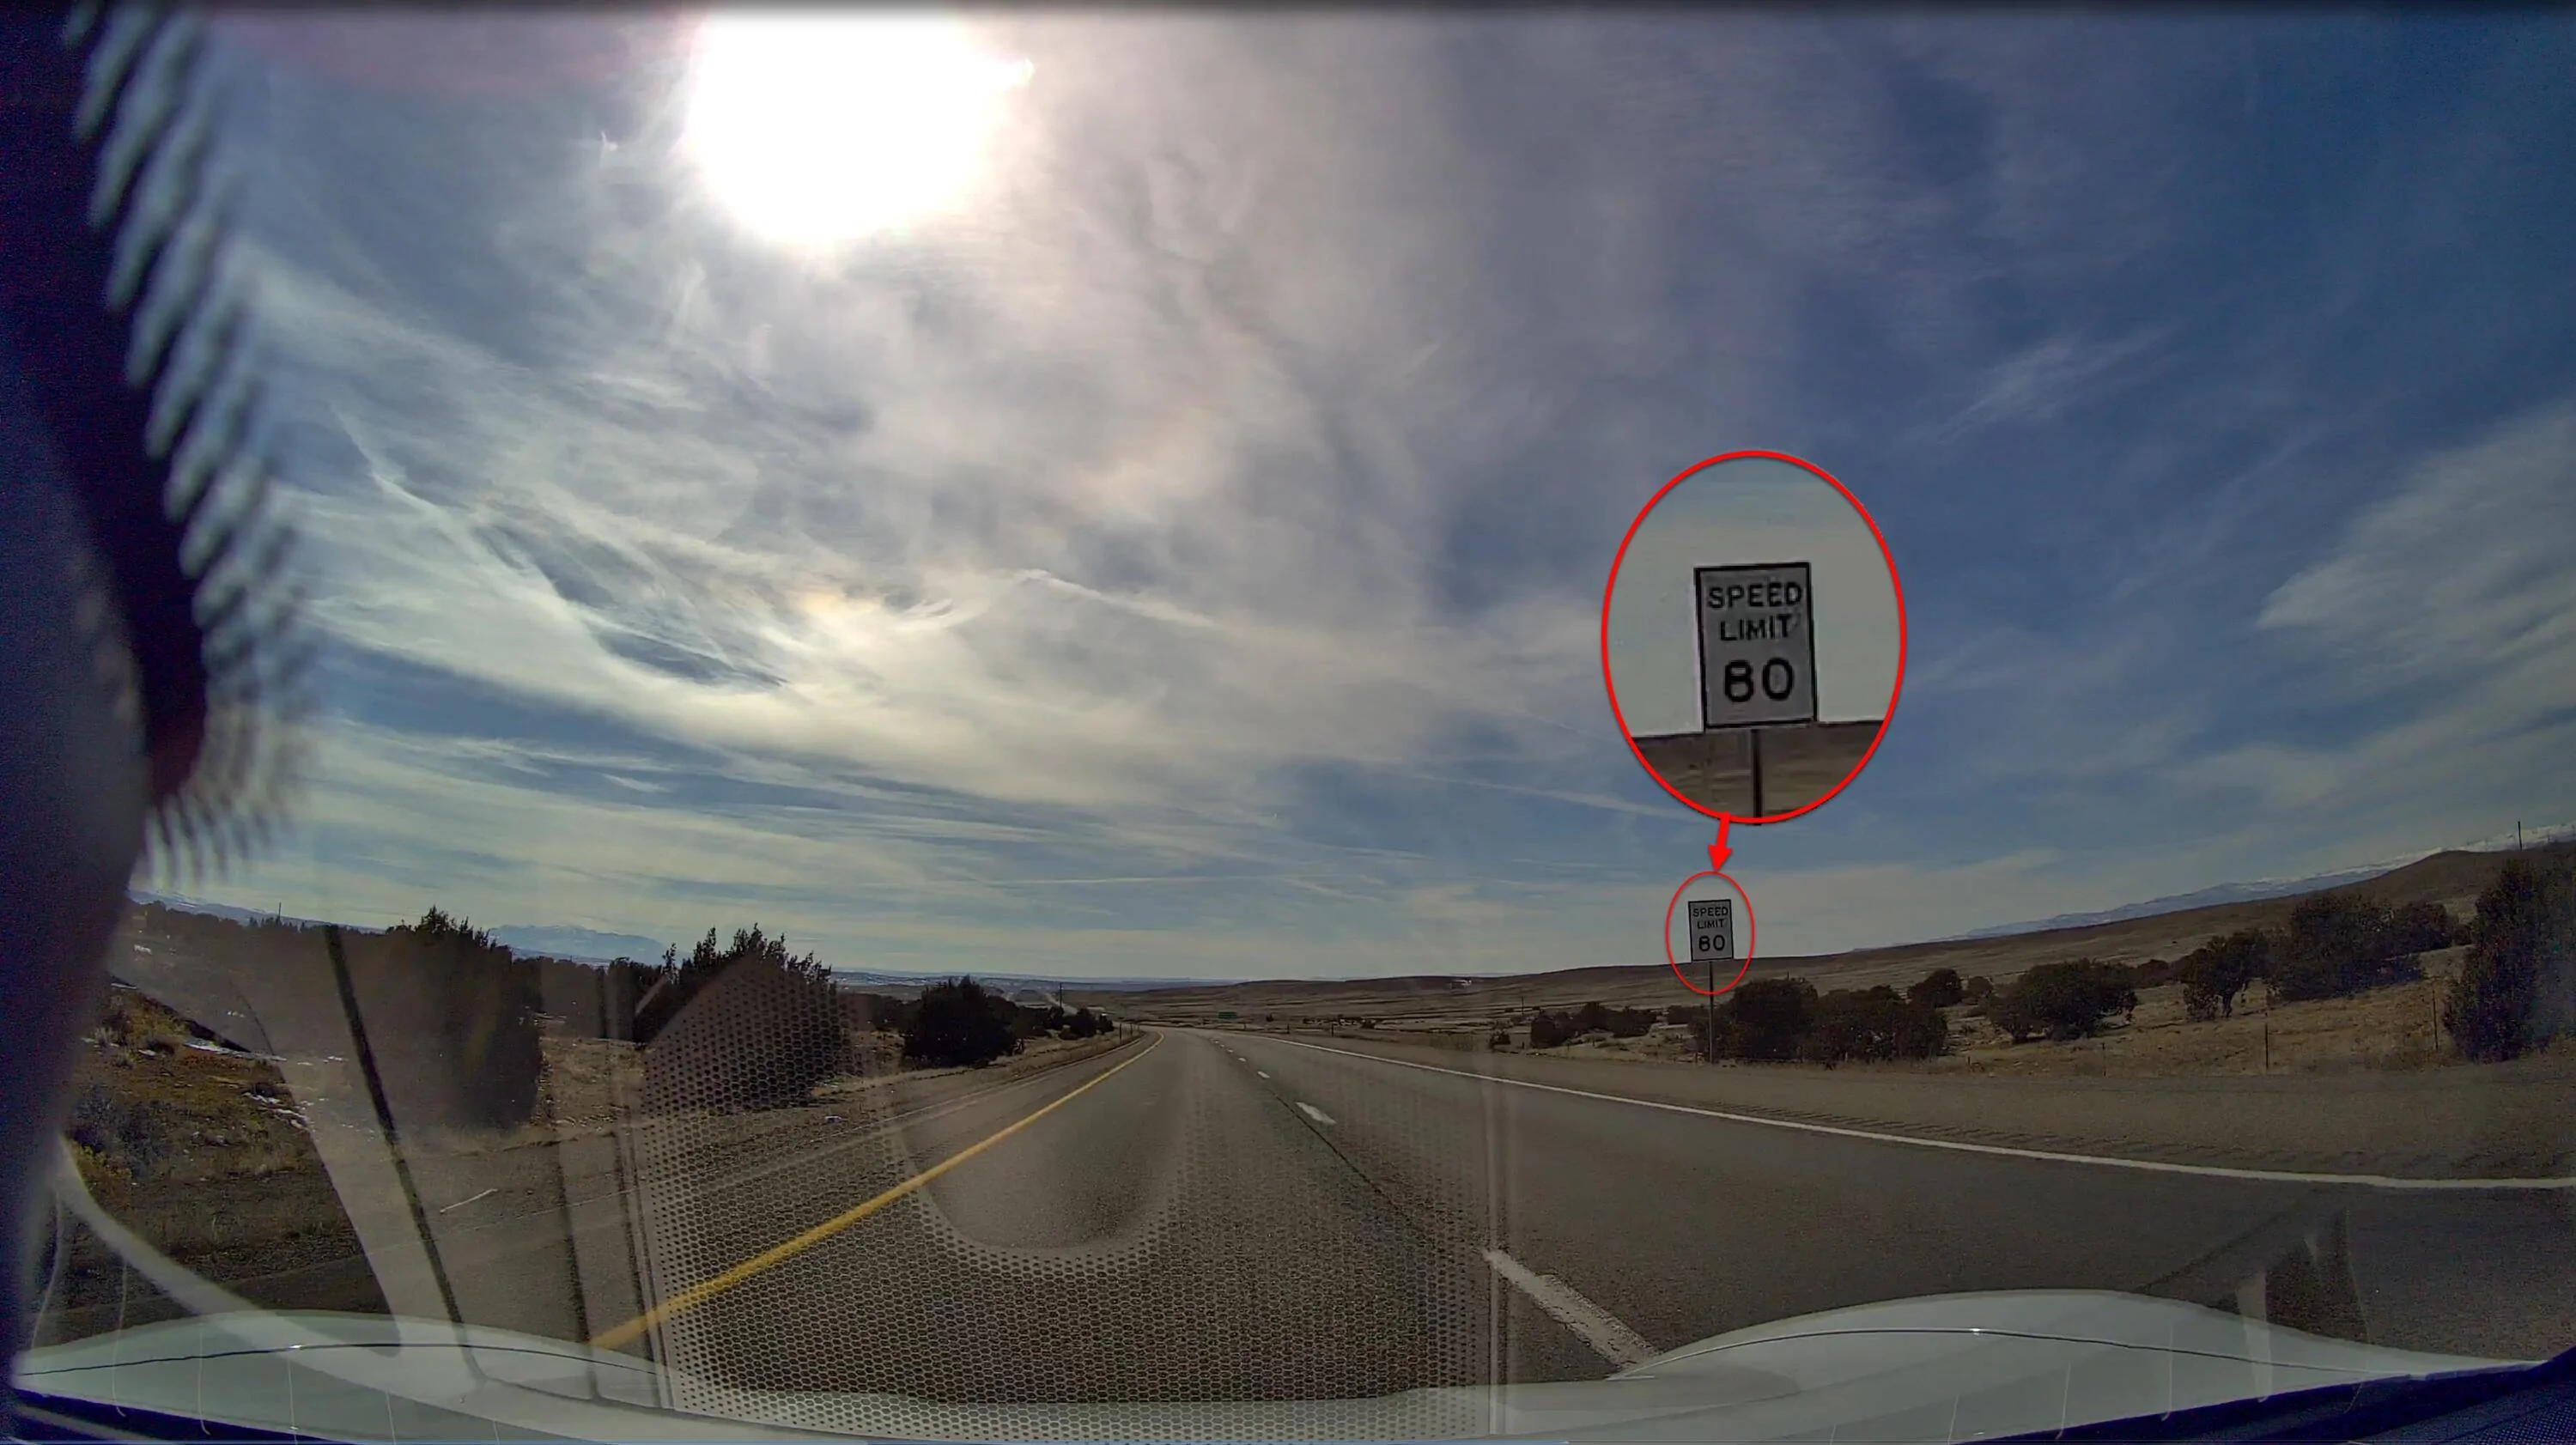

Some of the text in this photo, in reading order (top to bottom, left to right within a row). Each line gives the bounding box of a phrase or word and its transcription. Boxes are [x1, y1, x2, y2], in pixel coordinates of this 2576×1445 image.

[1692, 906, 1728, 918] SPEED
[1697, 918, 1724, 930] LIMIT
[1698, 934, 1725, 952] 80
